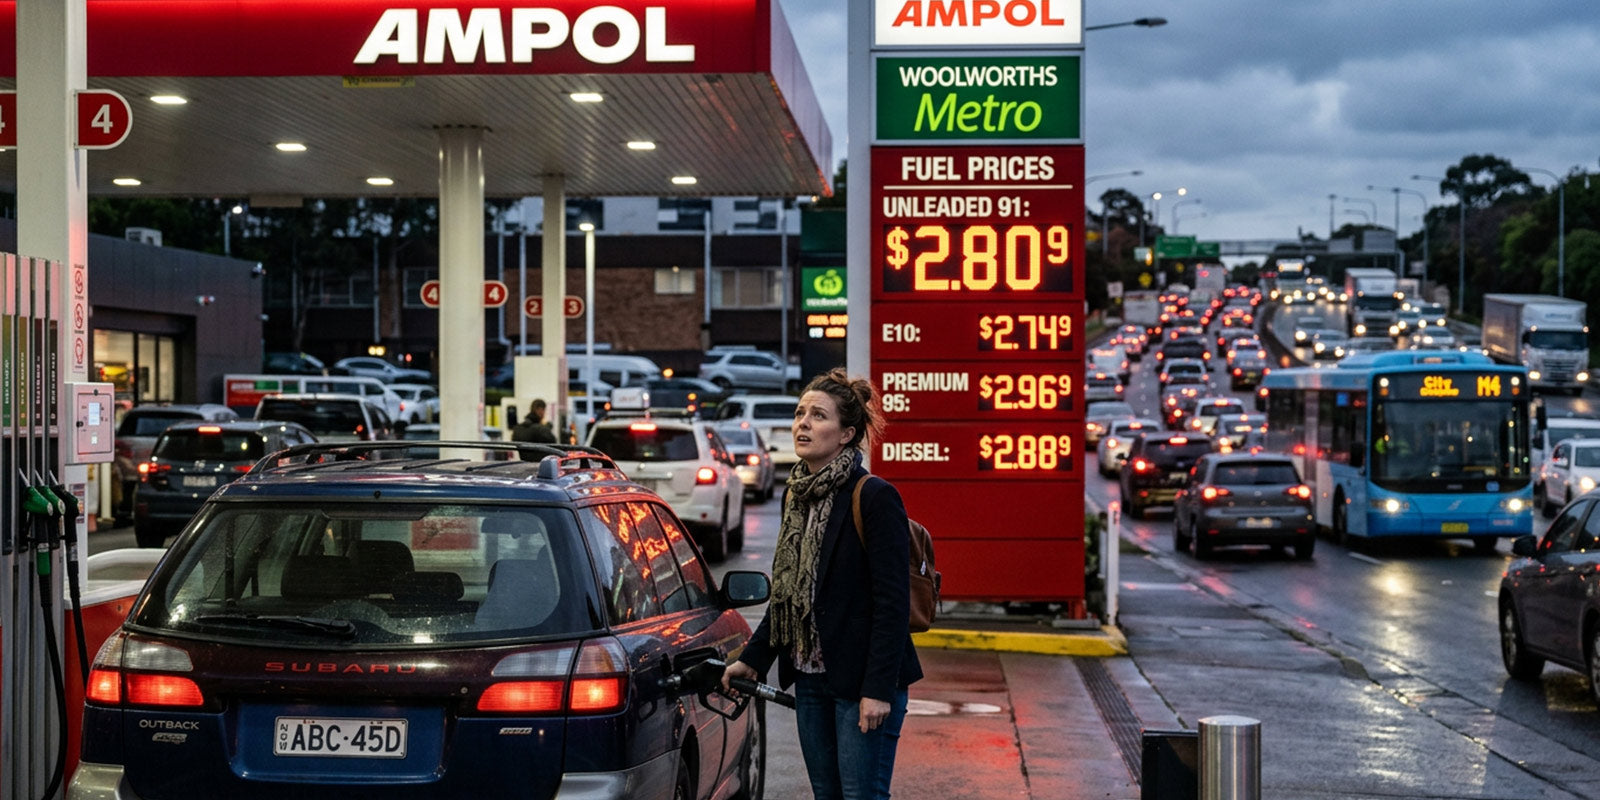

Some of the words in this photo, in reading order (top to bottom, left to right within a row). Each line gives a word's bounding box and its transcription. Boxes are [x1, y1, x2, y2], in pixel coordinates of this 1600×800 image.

[892, 0, 1065, 27] AMPOL
[353, 5, 695, 64] AMPOL
[899, 65, 1058, 87] WOOLWORTHS
[91, 104, 113, 134] 4
[914, 93, 1042, 133] Metro
[902, 156, 961, 181] FUEL
[968, 155, 1055, 181] PRICES
[883, 196, 992, 218] UNLEADED
[997, 196, 1030, 217] 91:
[427, 287, 438, 301] 4
[488, 287, 500, 301] 4
[529, 301, 539, 313] 2
[568, 301, 578, 313] 3
[882, 323, 921, 342] E10:
[882, 372, 969, 391] PREMIUM
[882, 393, 910, 412] 95:
[882, 442, 950, 461] DIESEL:
[265, 662, 416, 673] SUBARU
[139, 719, 199, 729] OUTBACK
